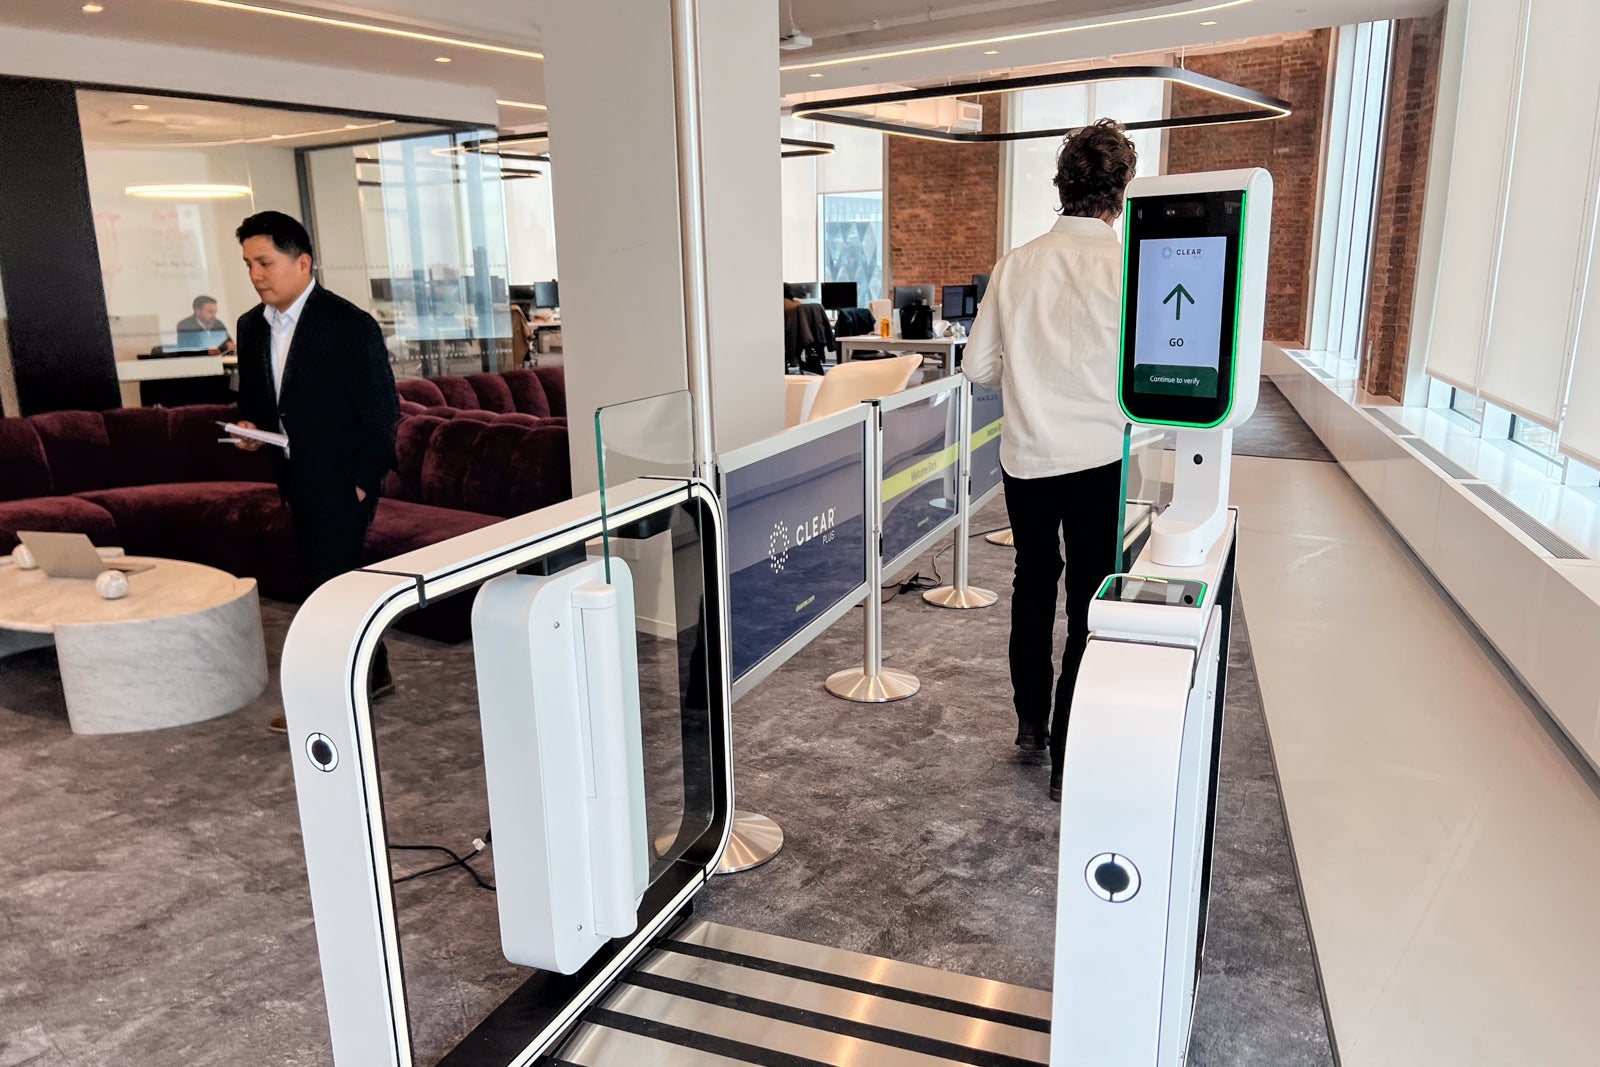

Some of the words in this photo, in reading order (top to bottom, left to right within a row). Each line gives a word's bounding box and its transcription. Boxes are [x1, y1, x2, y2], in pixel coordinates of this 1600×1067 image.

[1169, 337, 1184, 347] GO
[1150, 375, 1175, 384] Continue
[1184, 377, 1200, 387] verify
[796, 508, 835, 546] CLEAR
[822, 530, 836, 545] PLUS
